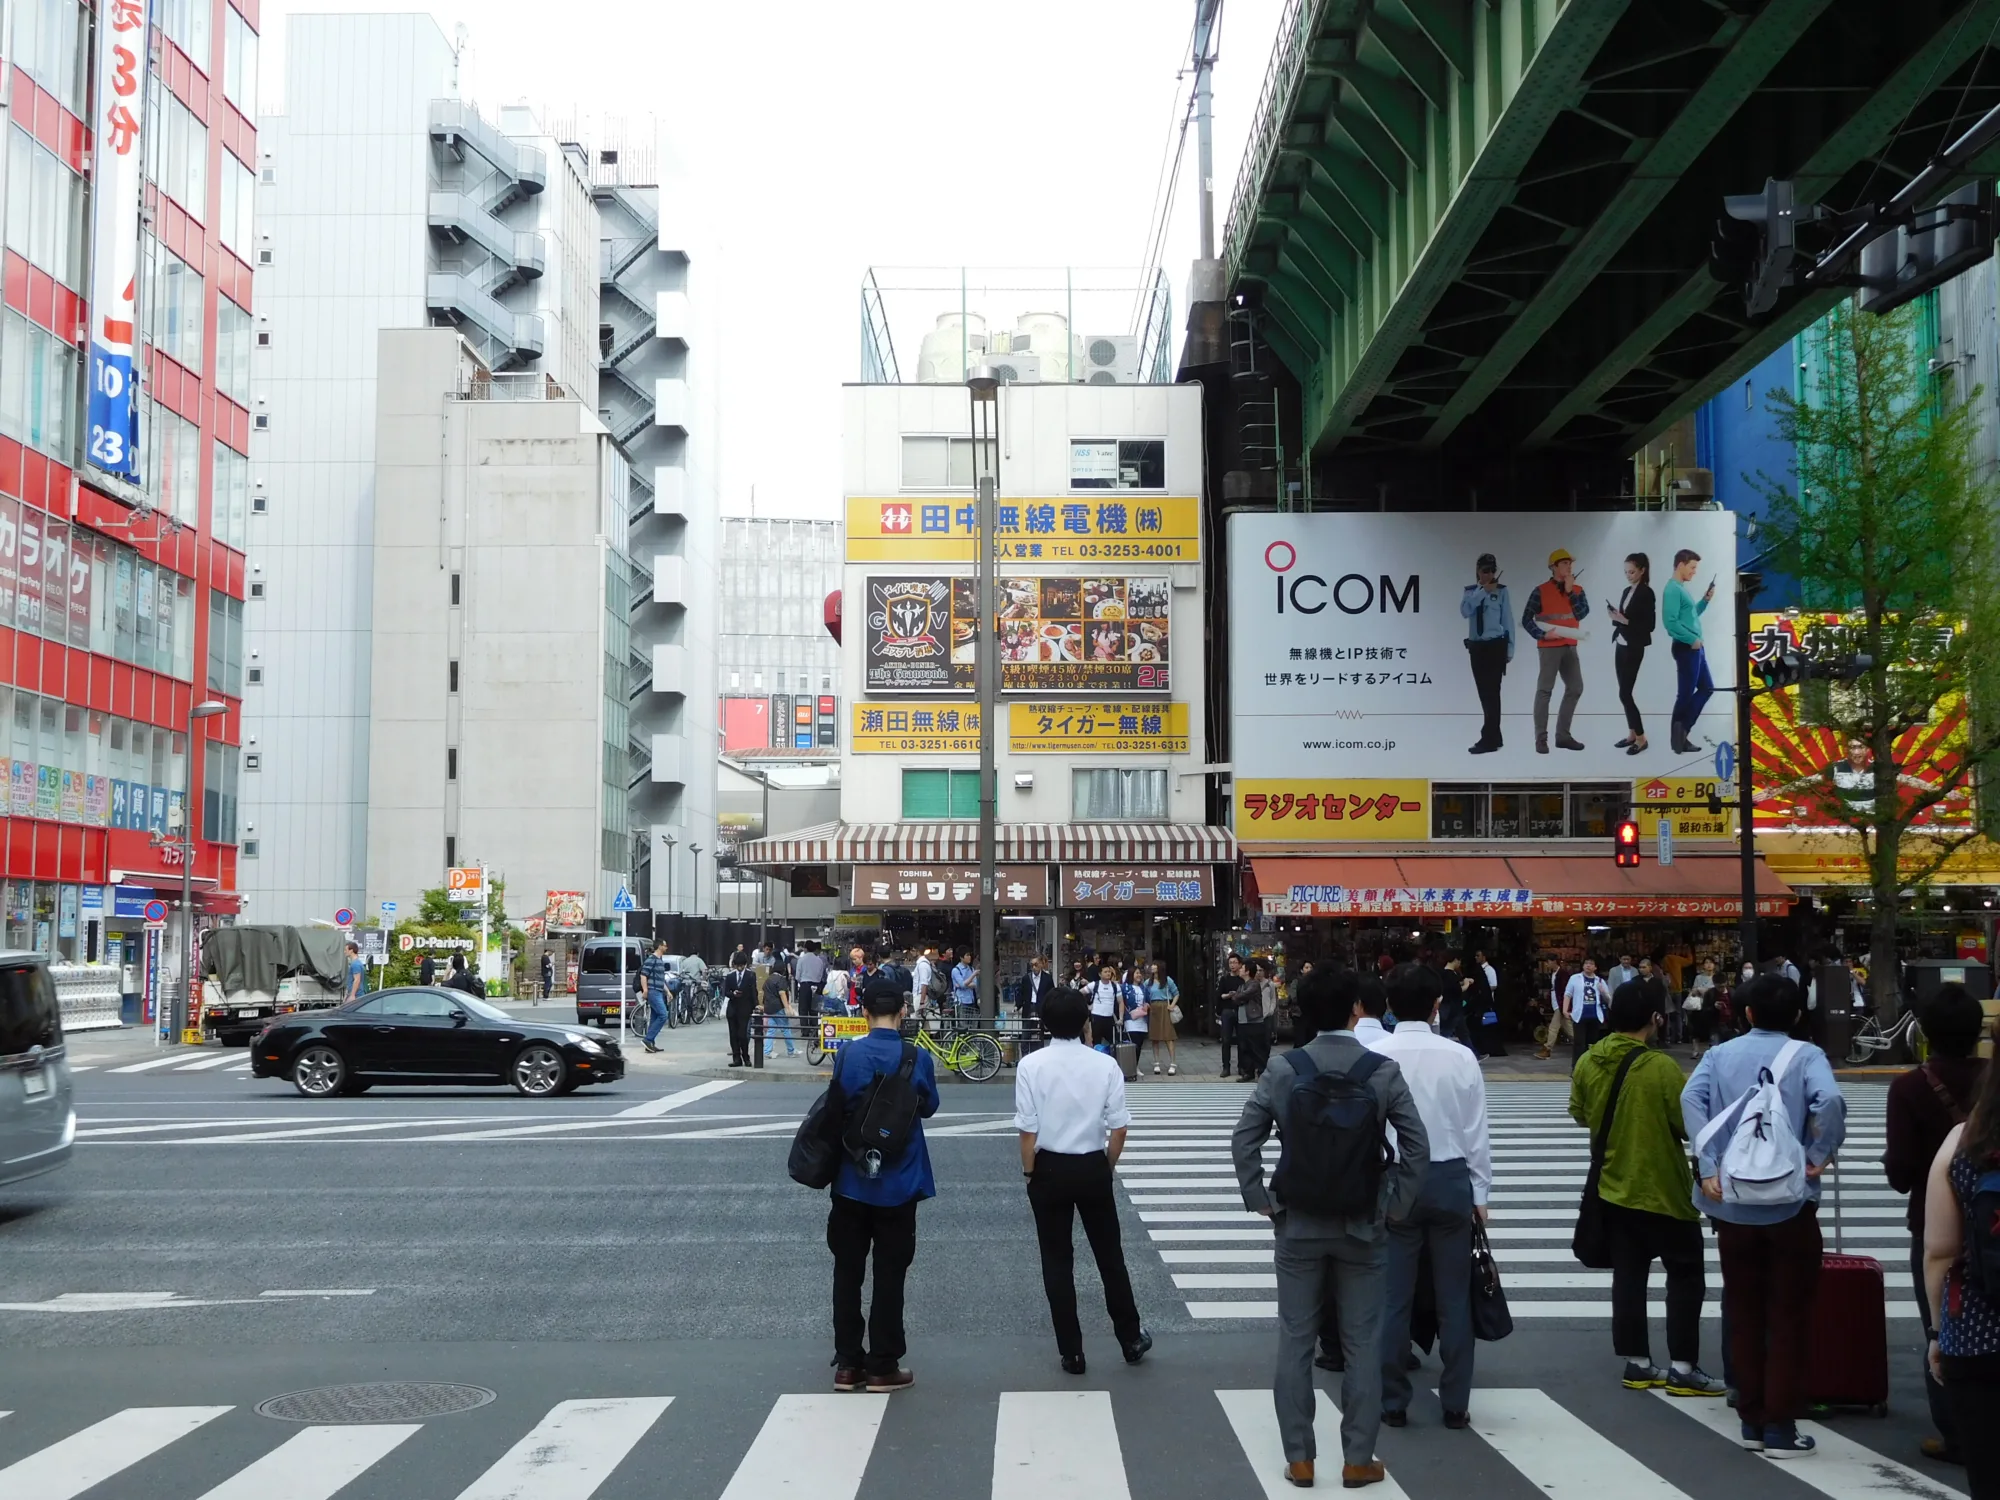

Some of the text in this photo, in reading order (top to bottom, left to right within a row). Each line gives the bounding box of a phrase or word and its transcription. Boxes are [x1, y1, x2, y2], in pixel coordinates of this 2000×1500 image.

[0, 512, 89, 594] カラオケ
[1052, 547, 1074, 555] TEL
[1079, 544, 1182, 557] 03-3253-4001
[931, 611, 948, 629] V
[1289, 648, 1407, 661] 無線機とIP技術で
[1137, 666, 1169, 687] 2F
[1264, 672, 1432, 686] 世界をリードするアイコム
[756, 705, 763, 714] 7
[1037, 715, 1162, 735] タイガー無線
[1117, 740, 1187, 749] 03-3251-6313
[1303, 739, 1396, 750] www.icom.co.jp
[1648, 788, 1666, 798] 2F
[1244, 793, 1421, 820] ラジオセンター
[1679, 822, 1723, 833] 昭和市場
[871, 882, 1027, 900] ミツワデキ
[1073, 881, 1202, 901] タイガー無線
[1292, 885, 1342, 903] FIGURE
[416, 937, 473, 951] D-Parking
